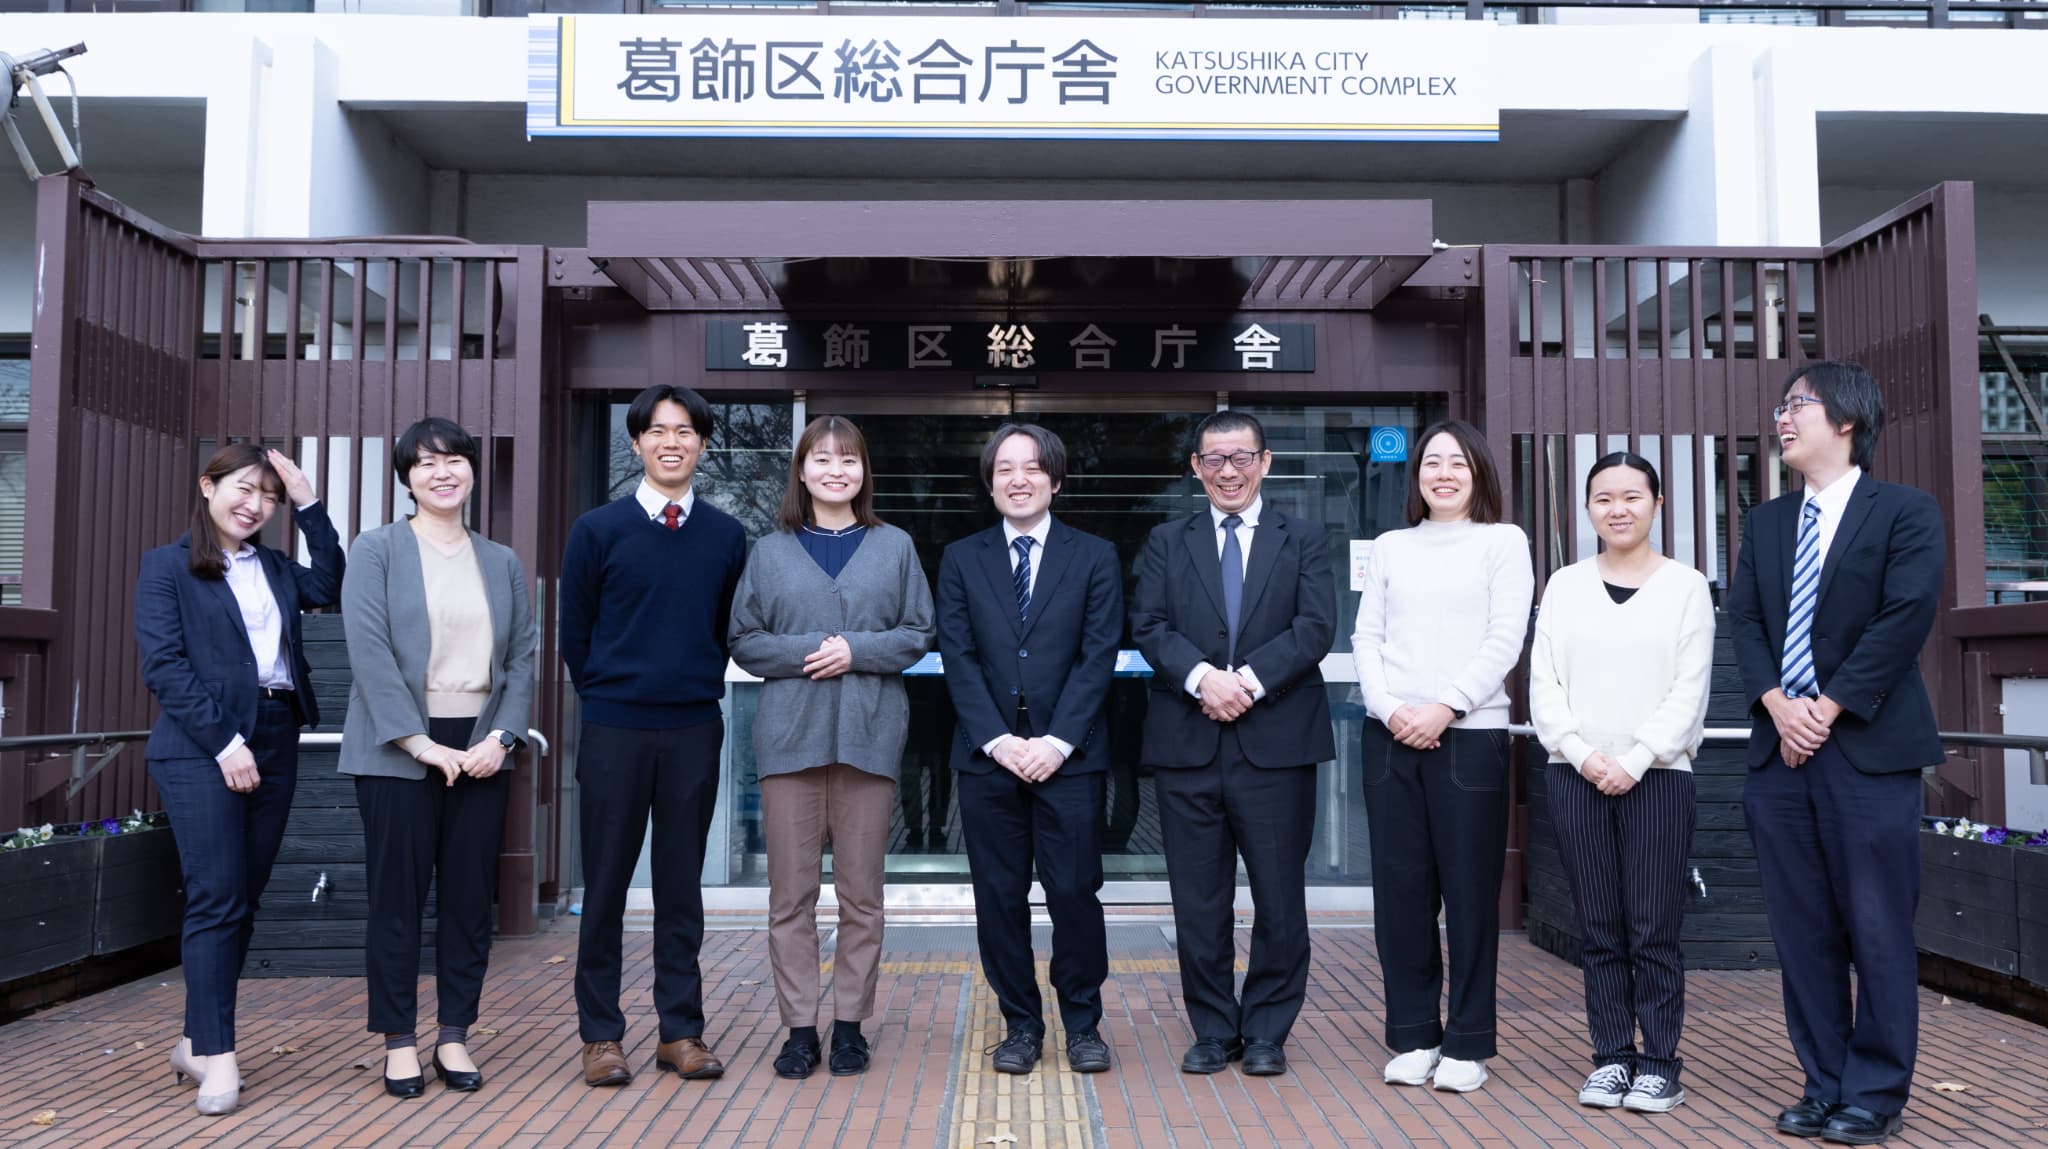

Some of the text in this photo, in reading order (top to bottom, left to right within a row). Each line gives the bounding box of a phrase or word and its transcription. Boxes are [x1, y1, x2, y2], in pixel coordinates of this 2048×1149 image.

[616, 36, 1118, 106] 葛飾区総合庁舎
[1155, 50, 1369, 71] KATSUSHIKA CITY
[1155, 74, 1457, 96] GOVERNMENT COMPLEX
[741, 321, 1282, 369] 葛飾区総合庁舎
